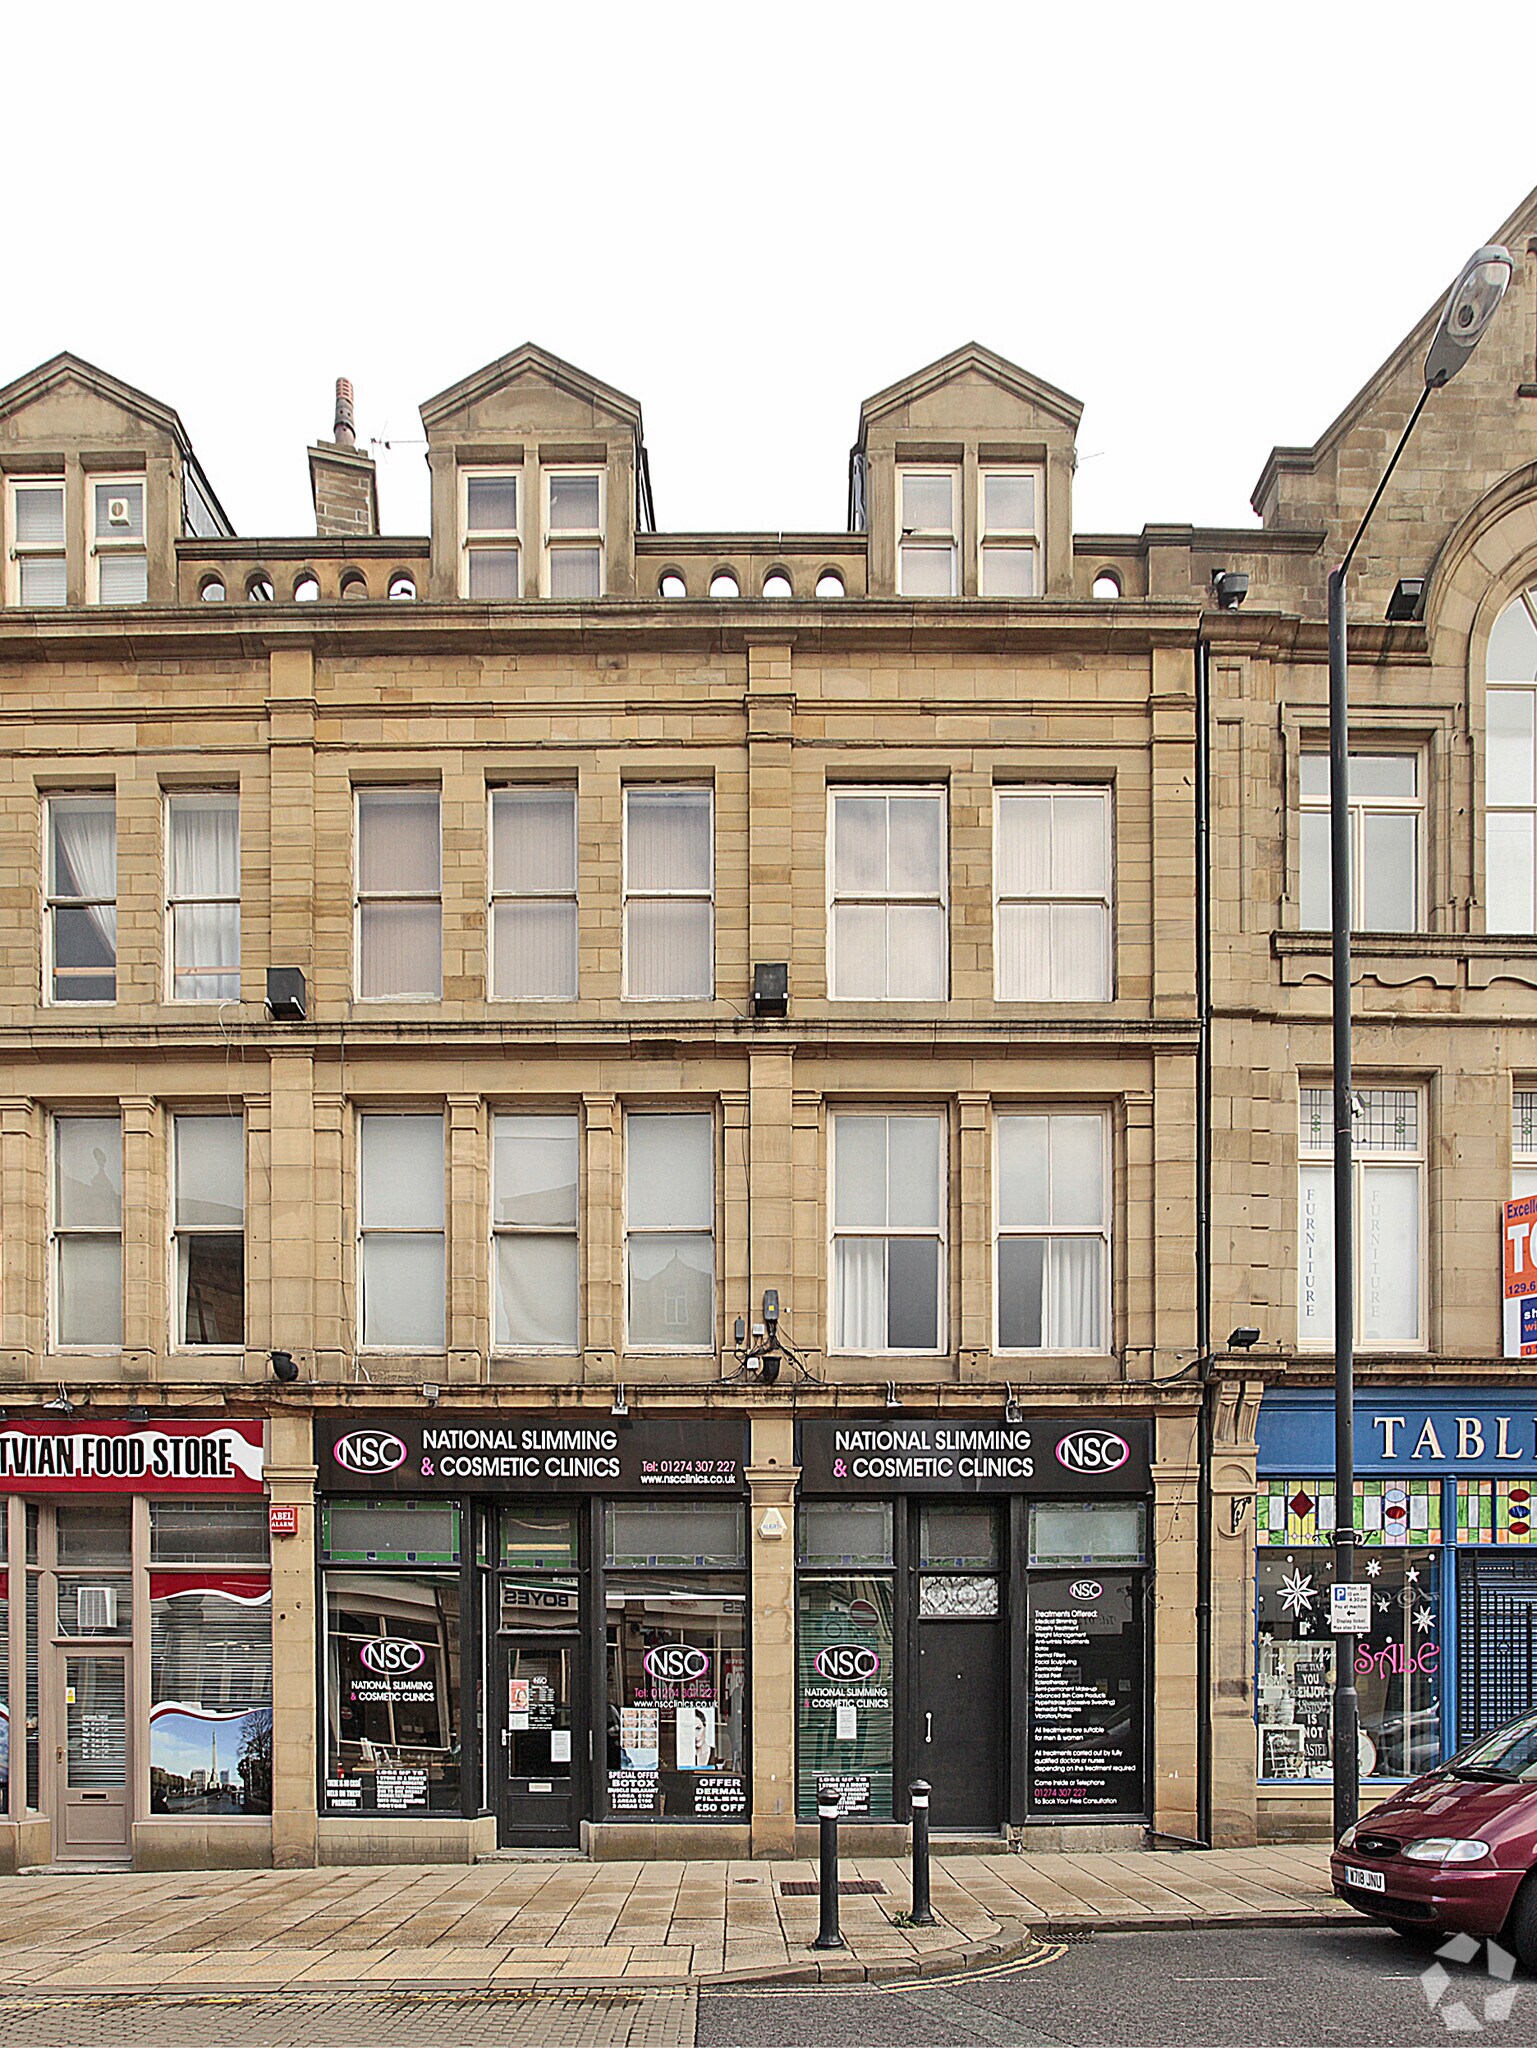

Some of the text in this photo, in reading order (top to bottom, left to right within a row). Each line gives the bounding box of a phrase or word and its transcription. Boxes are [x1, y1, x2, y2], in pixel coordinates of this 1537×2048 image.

[1507, 1199, 1537, 1219] Excell
[1305, 1188, 1316, 1317] FURNITURE
[1370, 1189, 1381, 1318] FURNITURE
[1508, 1281, 1536, 1295] 129.6
[422, 1430, 618, 1451] NATIONAL SLIMMING
[835, 1430, 1032, 1451] NATIONAL SLIMMING
[1374, 1416, 1537, 1459] TABL
[83, 1437, 147, 1476] FOOD
[152, 1437, 233, 1476] STORE
[342, 1437, 401, 1467] NSC
[1063, 1437, 1122, 1467] NSC
[420, 1457, 620, 1477] & COSMETIC CLINICS
[641, 1460, 736, 1472] Tel: 01274 307 227
[832, 1457, 1034, 1478] & COSMETIC CLINICS
[640, 1474, 736, 1484] www.nscclinics.co.uk
[271, 1512, 293, 1520] ABEL
[367, 1643, 419, 1669] NSC
[1354, 1643, 1441, 1680] SALE
[650, 1650, 704, 1676] NSC
[820, 1650, 873, 1676] NSC
[351, 1681, 433, 1690] NATIONAL SLIMMING
[1301, 1673, 1320, 1685] YOU
[350, 1692, 435, 1701] & COSMETIC CLINICS
[634, 1687, 649, 1698] Tel:
[650, 1687, 679, 1698] 01274
[699, 1687, 718, 1698] 227
[804, 1688, 888, 1697] NATIONAL SLIMMING
[1297, 1685, 1326, 1698] ENJOY
[811, 1699, 855, 1708] COSMETIC
[856, 1699, 889, 1708] CLINICS
[1307, 1714, 1318, 1724] IS
[1304, 1726, 1324, 1739] NOT
[608, 1771, 659, 1780] SPECIAL OFFER
[611, 1779, 656, 1788] BOTOX
[699, 1778, 741, 1787] OFFER
[695, 1787, 744, 1795] DERMAL
[695, 1803, 745, 1812] £50 OFF
